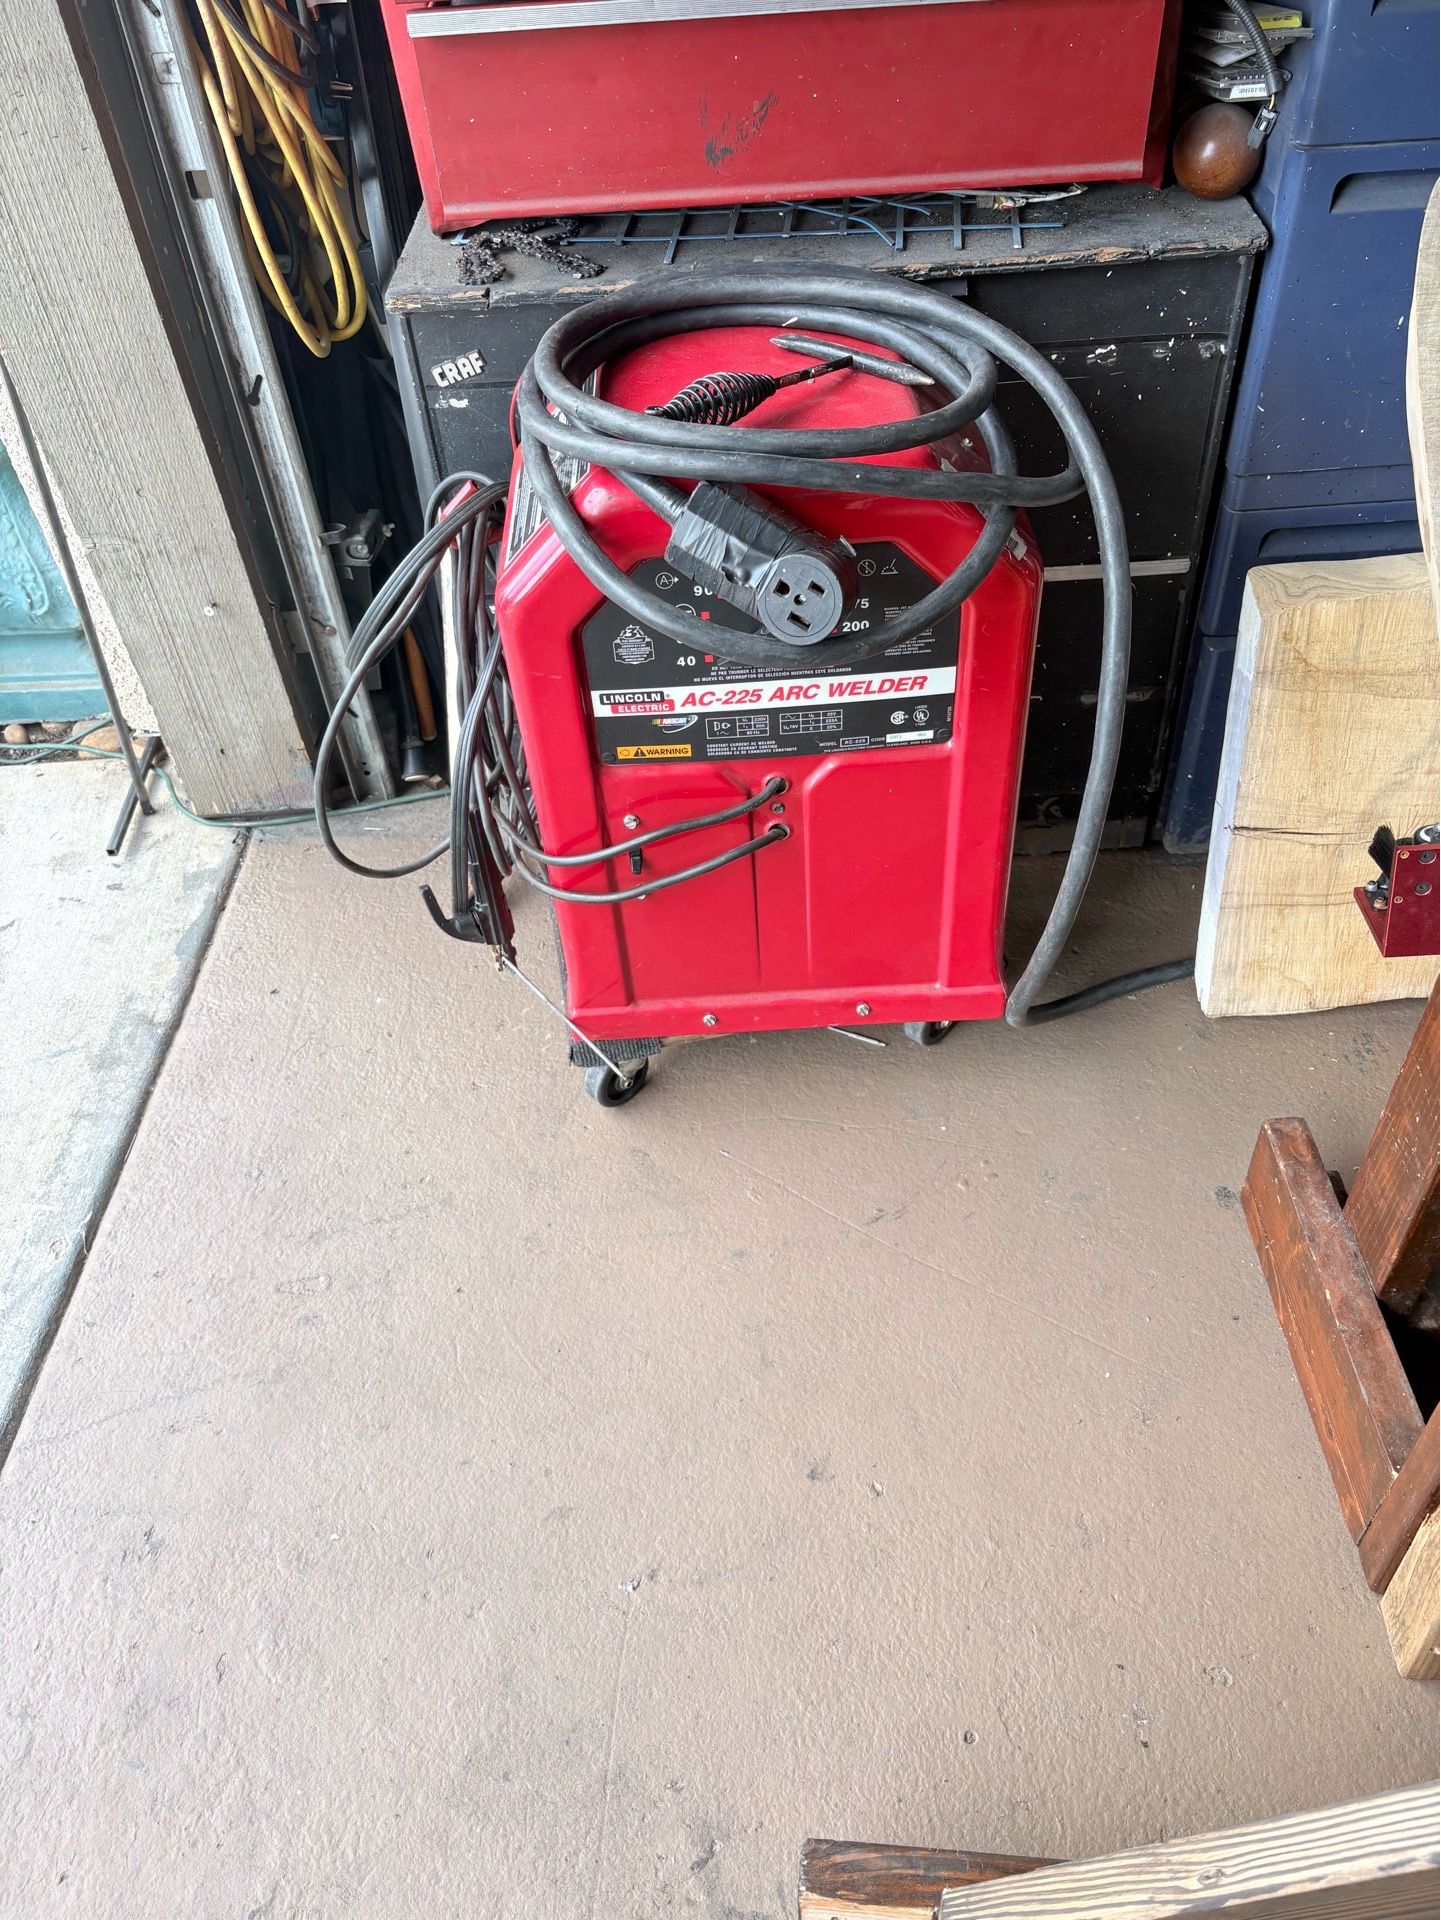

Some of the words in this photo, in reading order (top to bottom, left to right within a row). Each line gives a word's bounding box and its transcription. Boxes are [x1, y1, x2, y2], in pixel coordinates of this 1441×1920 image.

[431, 351, 485, 388] CRAF
[842, 620, 869, 632] 200
[677, 656, 696, 666] 40
[680, 689, 763, 707] AC-225
[768, 684, 820, 702] ARC
[828, 675, 928, 698] WELDER
[603, 693, 661, 704] LINCOLN
[619, 703, 670, 713] ELECTRIC
[662, 717, 687, 725] NASCAR
[646, 747, 689, 756] WARNING
